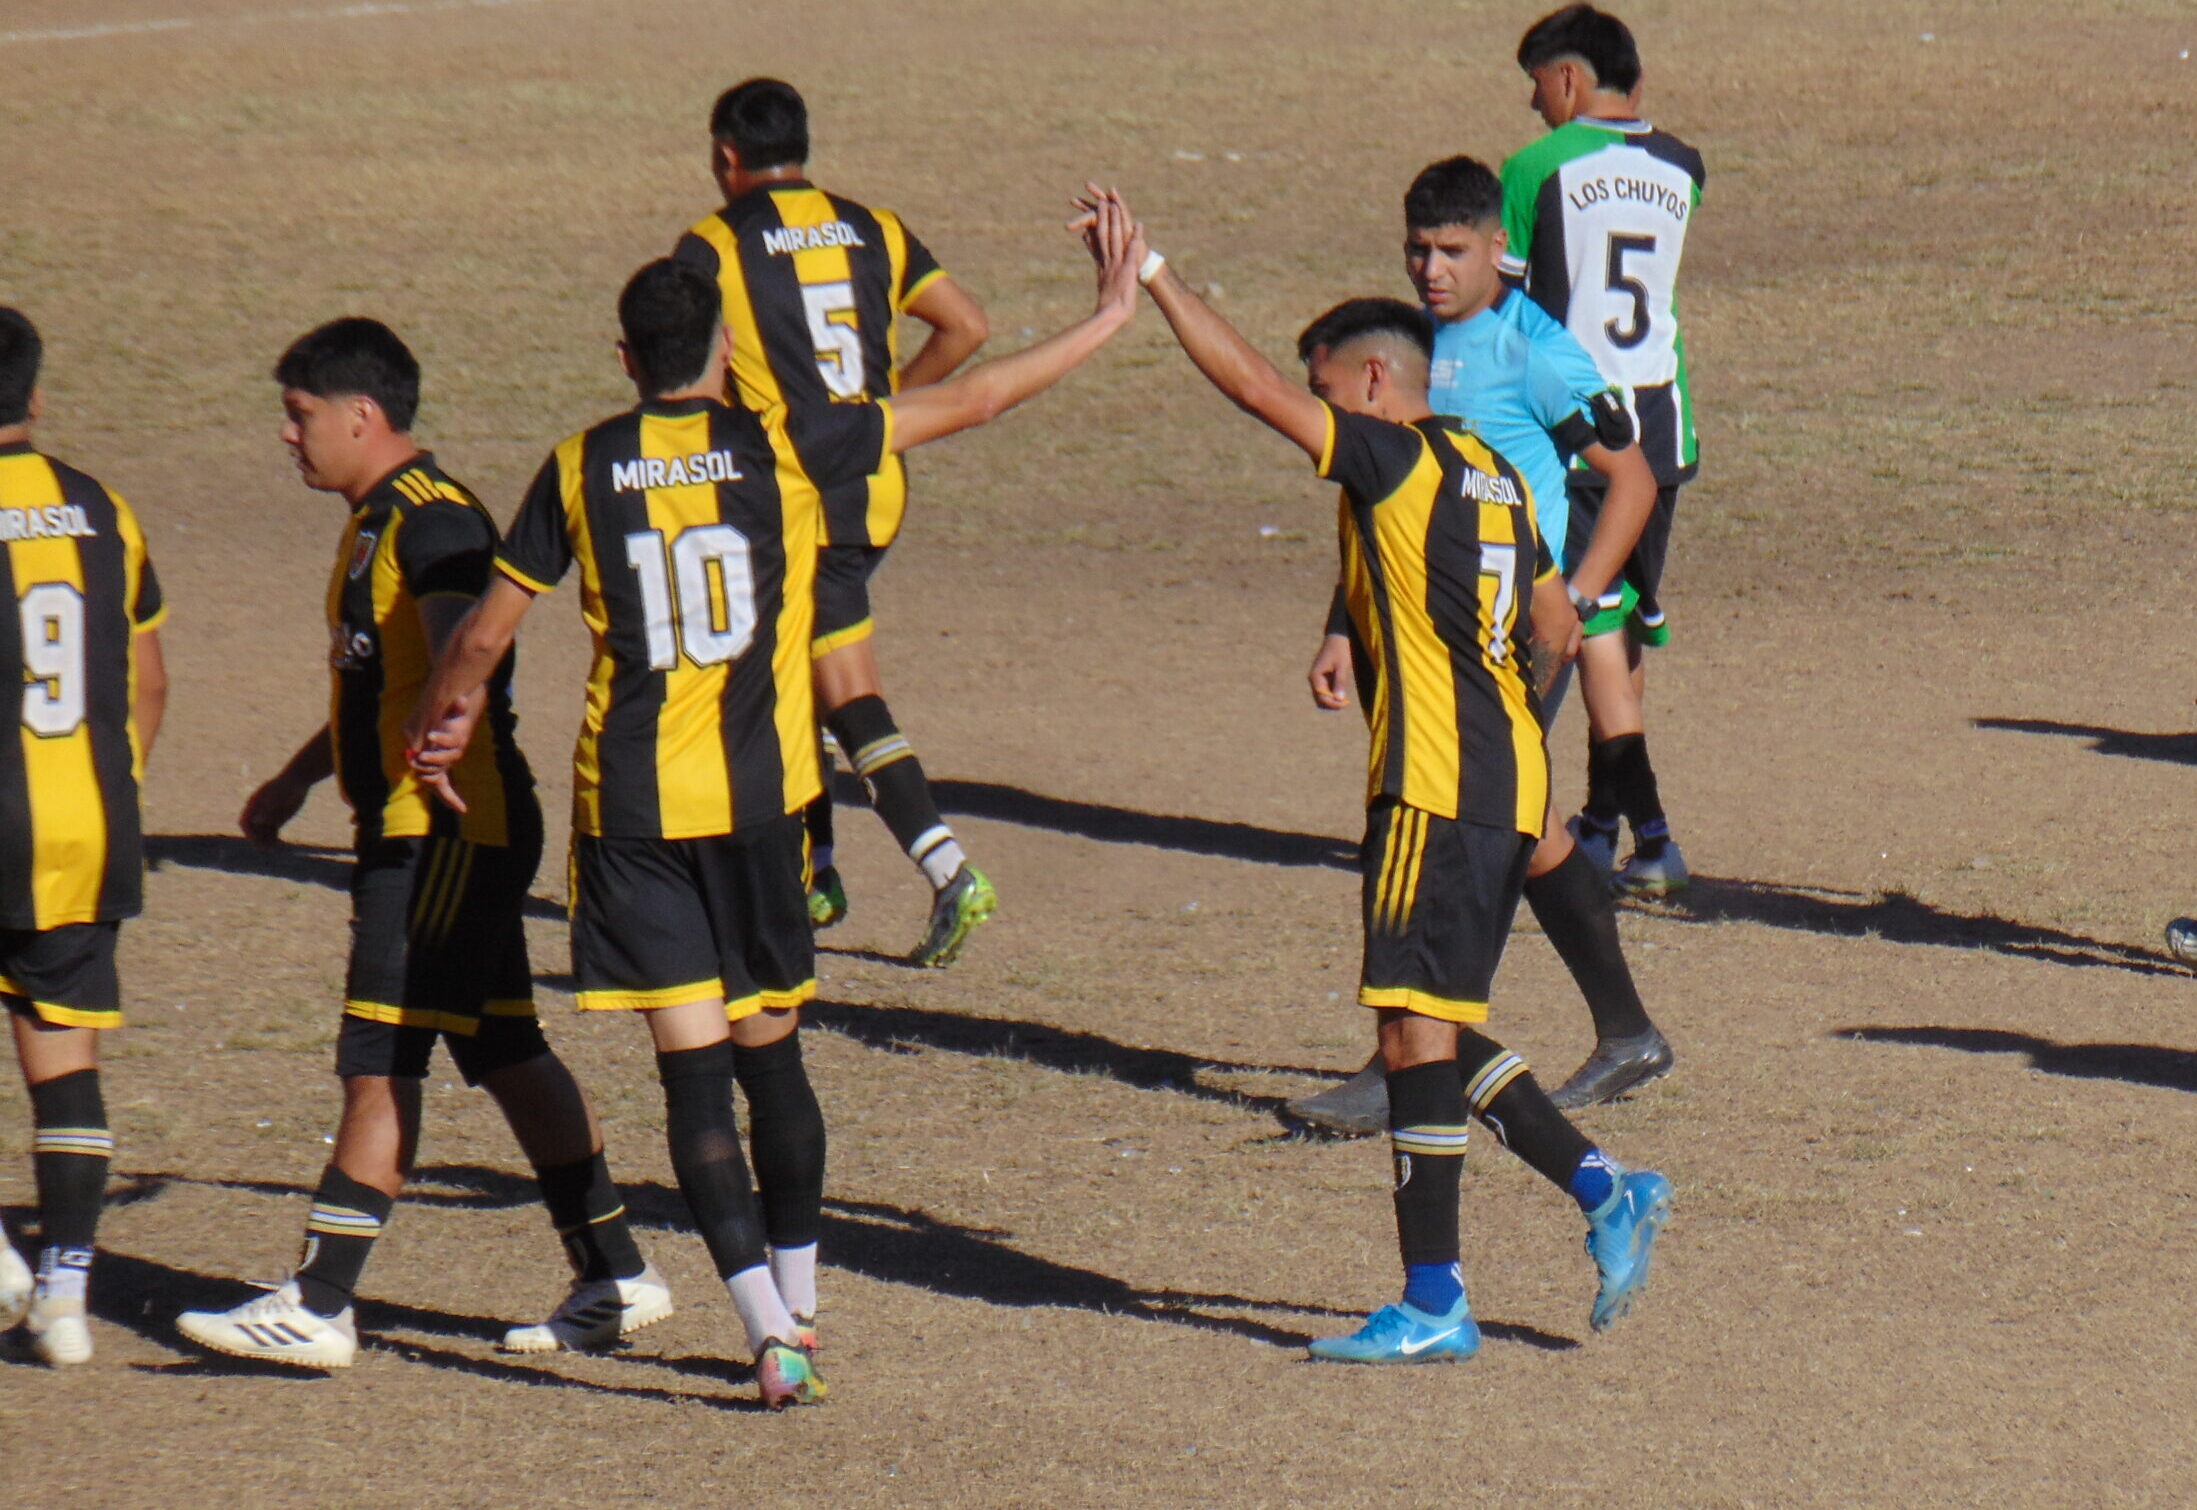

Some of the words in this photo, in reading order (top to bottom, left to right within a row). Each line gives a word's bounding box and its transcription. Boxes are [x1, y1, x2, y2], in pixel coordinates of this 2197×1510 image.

[762, 221, 865, 255] MIRASOL
[1569, 177, 1609, 211] LOS
[1614, 176, 1687, 221] CHUYOS
[1604, 230, 1656, 349] 5
[801, 281, 865, 399] 5
[612, 450, 743, 492] MIRASOL
[1461, 467, 1522, 505] MIRASOL
[0, 505, 97, 541] IRASOL
[624, 523, 757, 670] 10
[1480, 544, 1517, 667] 7
[20, 582, 86, 739] 9
